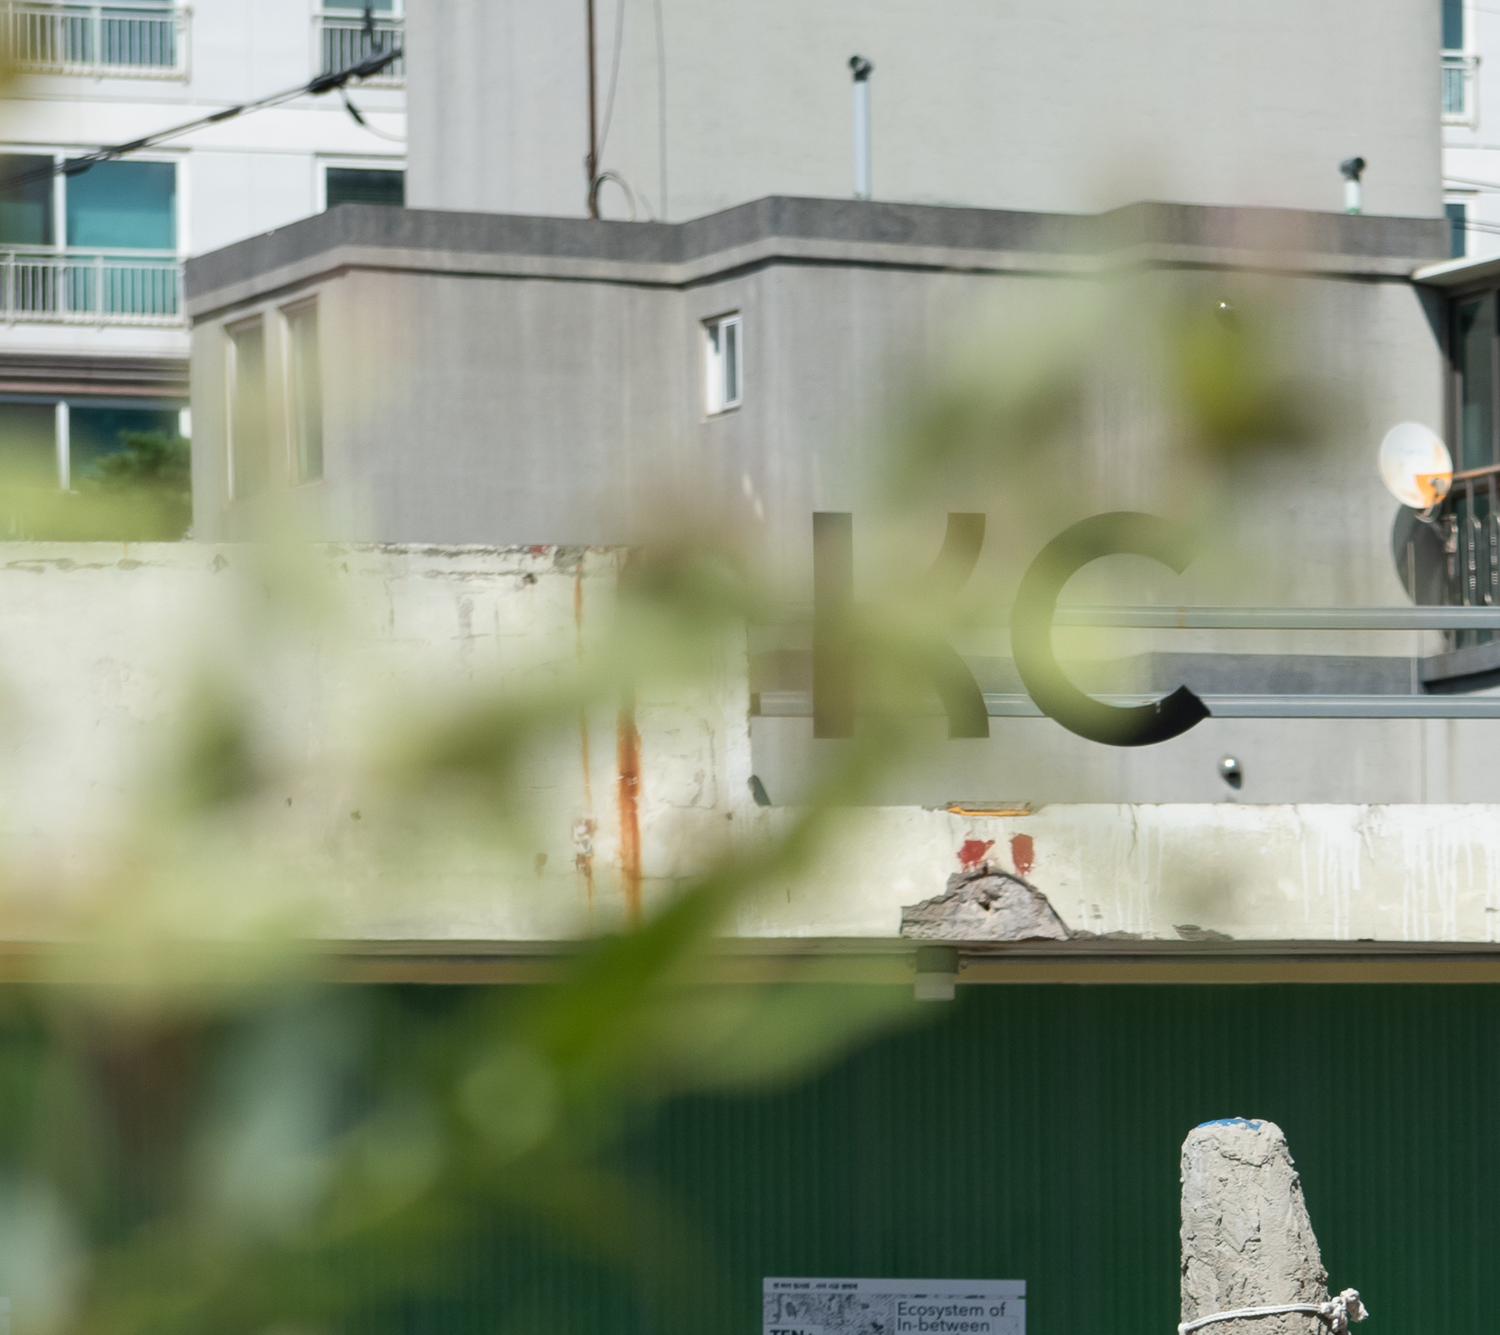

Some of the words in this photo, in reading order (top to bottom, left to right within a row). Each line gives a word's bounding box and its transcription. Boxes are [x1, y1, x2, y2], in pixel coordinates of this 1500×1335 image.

[897, 1302, 984, 1320] Ecosystem
[989, 1301, 1006, 1317] of
[897, 1318, 990, 1332] In-between
